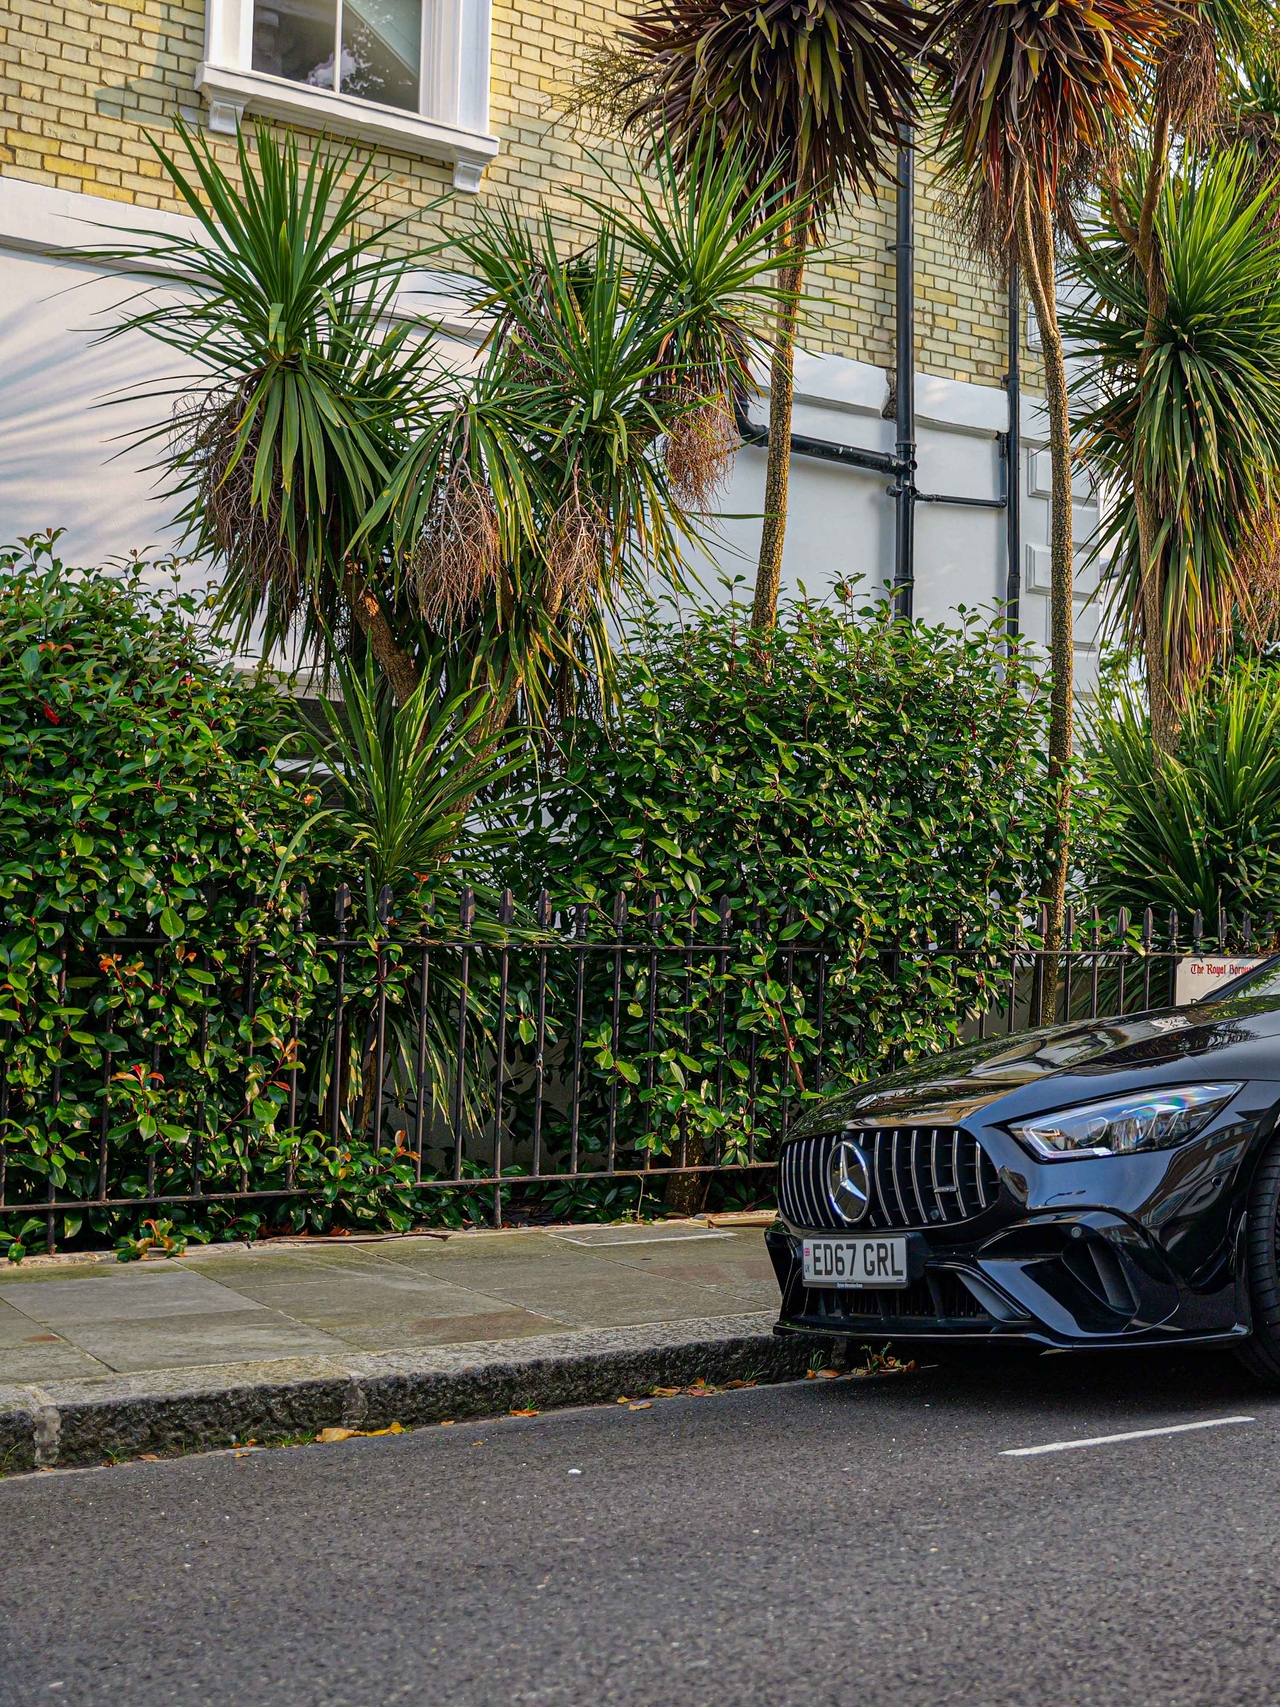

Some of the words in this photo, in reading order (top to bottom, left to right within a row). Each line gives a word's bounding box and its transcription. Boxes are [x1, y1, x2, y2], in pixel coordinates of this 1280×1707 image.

[1190, 963, 1204, 975] The
[1206, 963, 1226, 978] Royal
[812, 1243, 857, 1276] ED67
[863, 1242, 904, 1276] GRL
